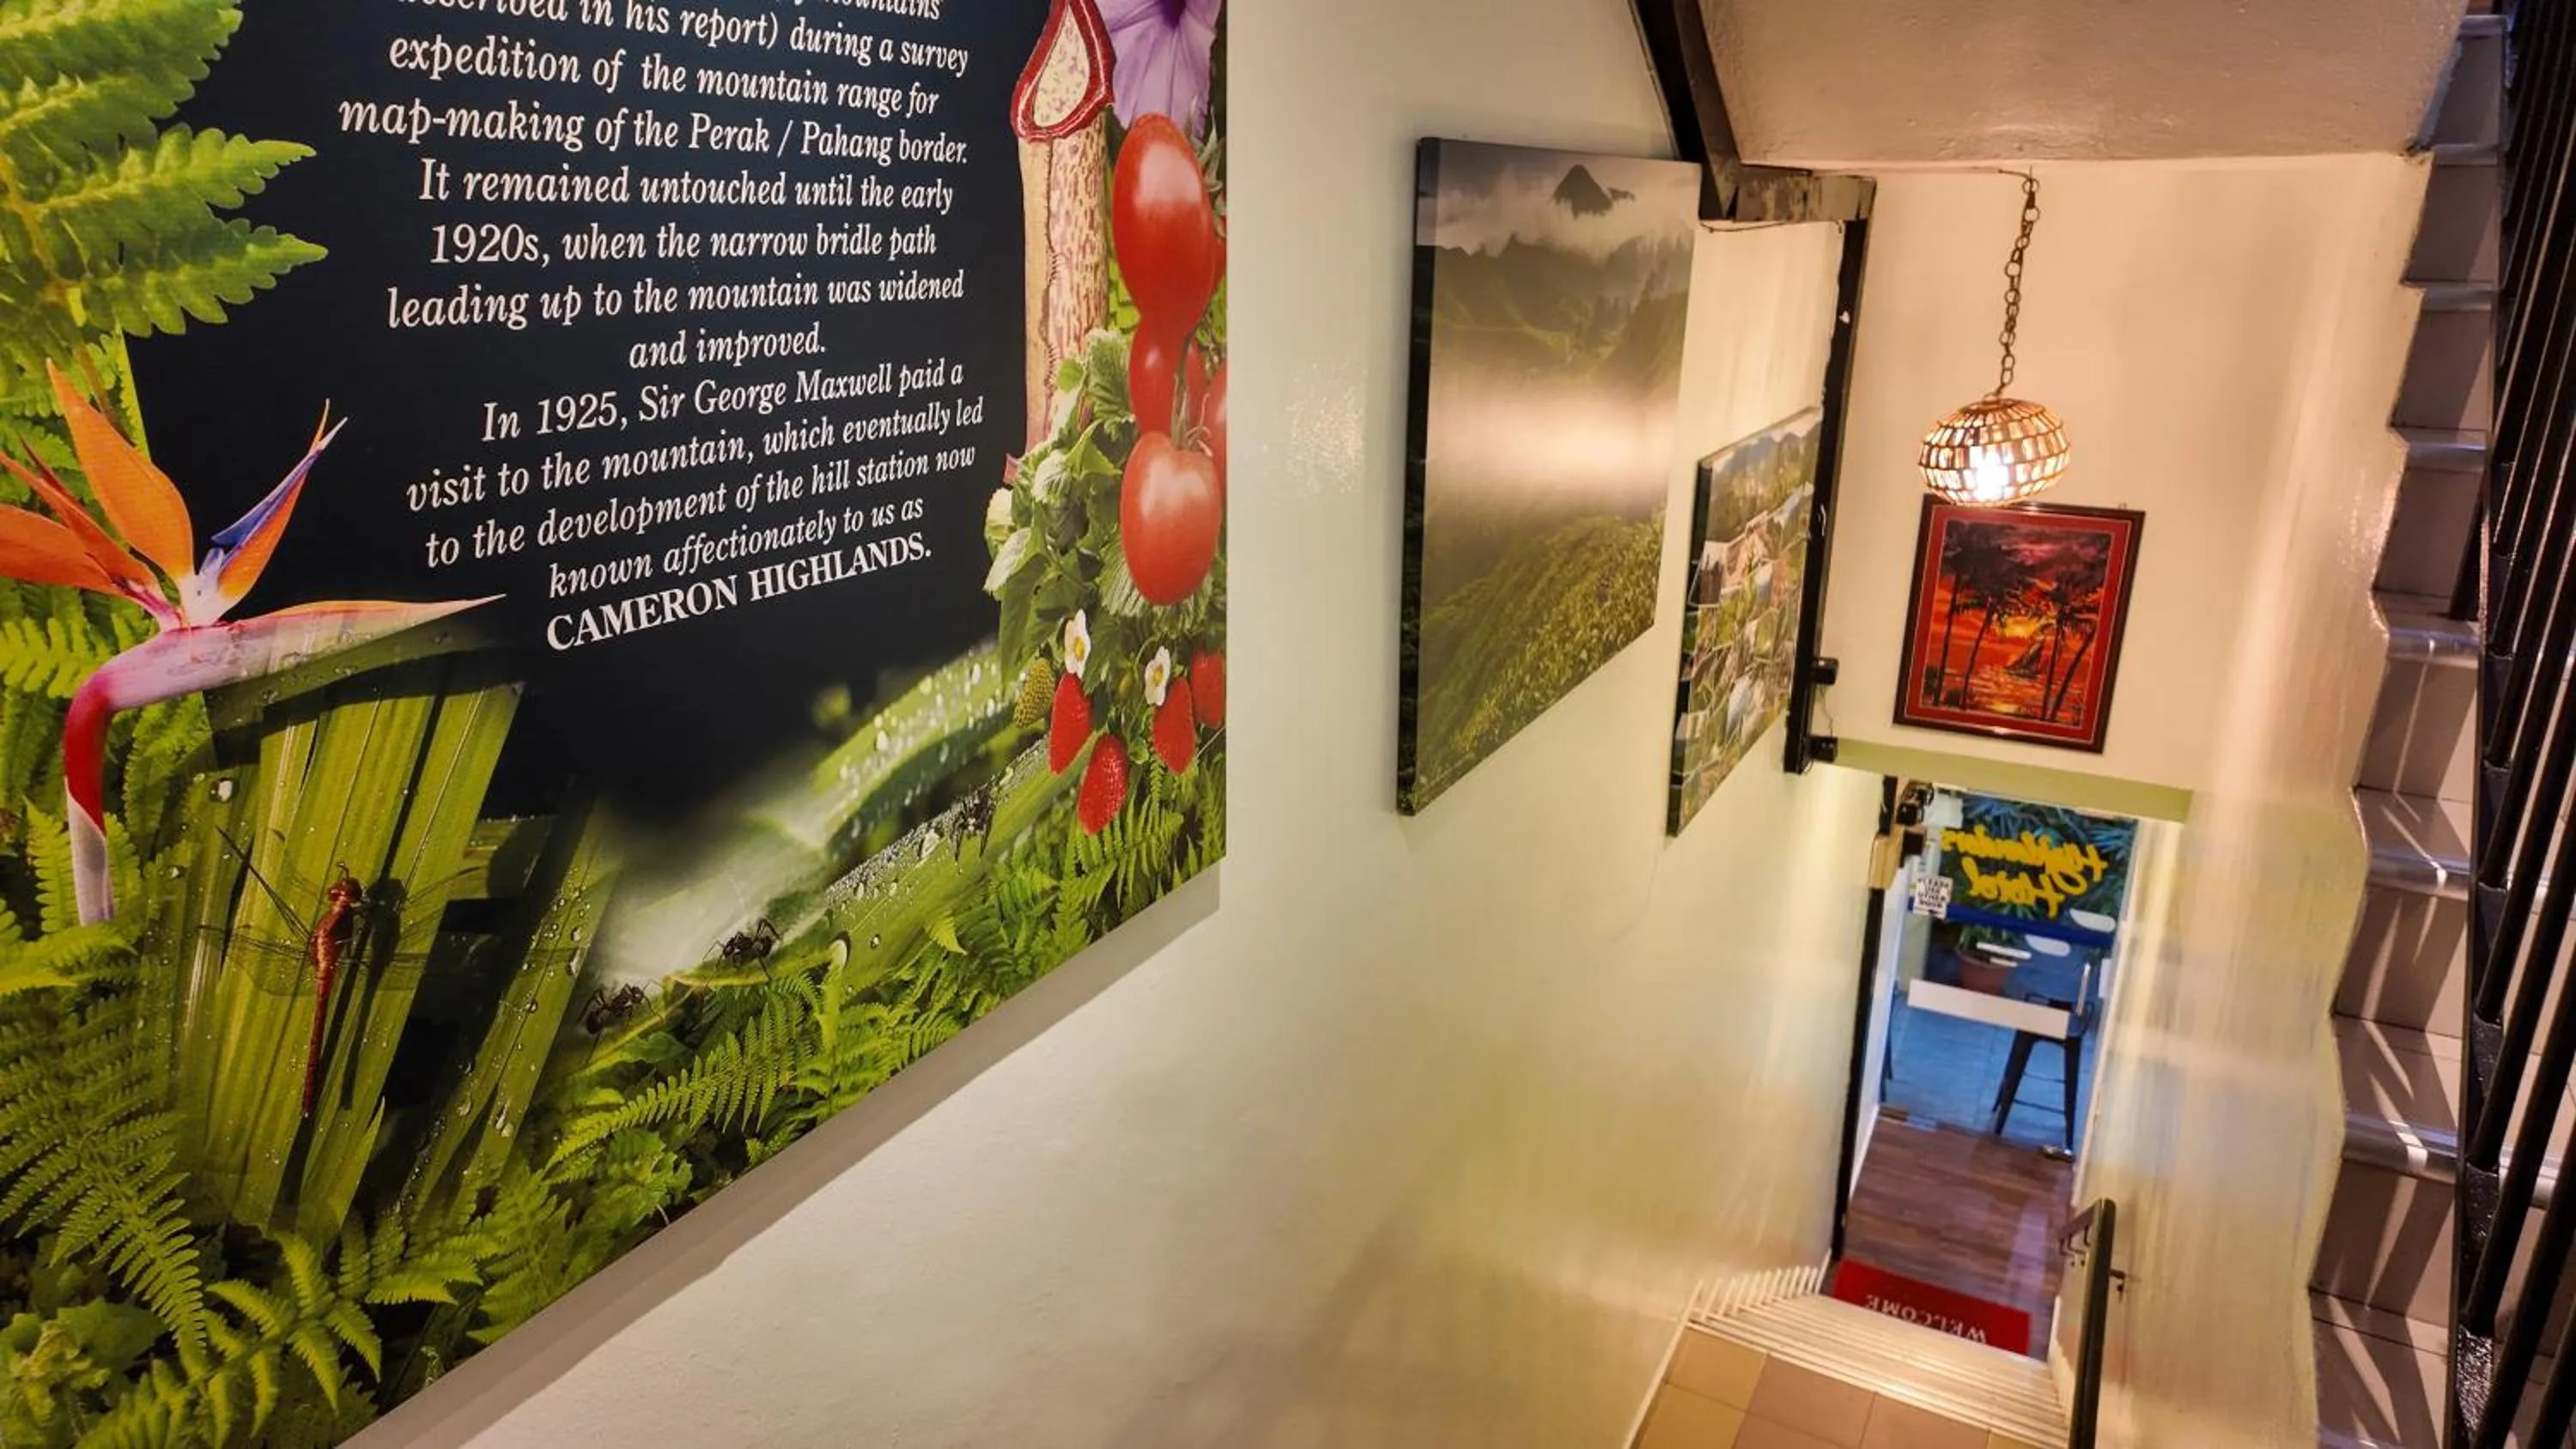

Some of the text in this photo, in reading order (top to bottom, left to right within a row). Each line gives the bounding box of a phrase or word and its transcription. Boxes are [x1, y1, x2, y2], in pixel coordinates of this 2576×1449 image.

[389, 33, 939, 118] expedition of the mountain range for
[579, 0, 614, 27] in
[625, 0, 671, 34] his
[679, 7, 779, 50] report)
[789, 16, 873, 67] during
[878, 38, 894, 63] a
[900, 40, 969, 78] survey
[338, 97, 967, 167] map-making of the Perak / Pahang border.
[418, 158, 953, 215] It remained untouched until the early
[430, 221, 937, 268] 1920s, when the narrow bridle path
[387, 269, 964, 330] leading up to the mountain was widened
[629, 320, 826, 369] and improved.
[482, 357, 963, 441] In 1925, Sir George Maxwell paid a
[406, 395, 983, 512] visit to the mountain, which eventually led
[425, 446, 975, 568] to the development of the hill station now
[550, 498, 923, 598] known affectionately to us as
[547, 531, 932, 650] CAMERON HIGHLANDS.
[1865, 1294, 1987, 1343] WELCOME
